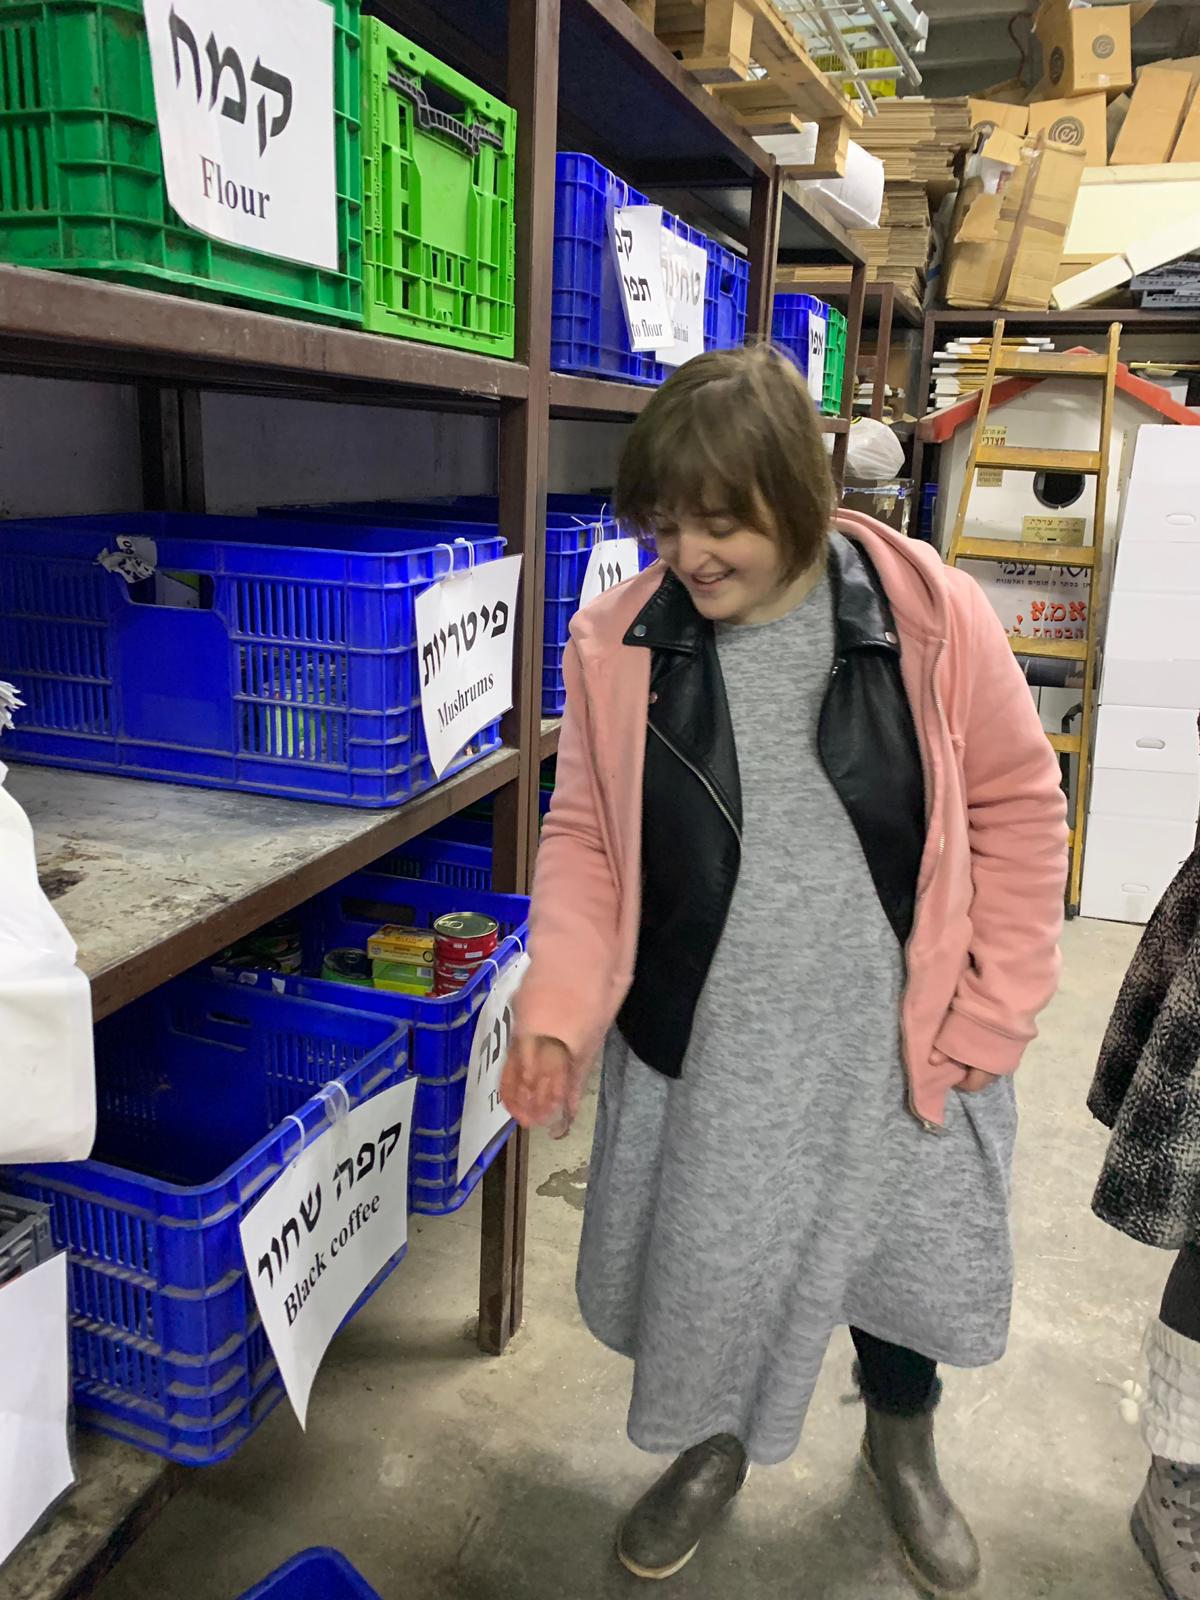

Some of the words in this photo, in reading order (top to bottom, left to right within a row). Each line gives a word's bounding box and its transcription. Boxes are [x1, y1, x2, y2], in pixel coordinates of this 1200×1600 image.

[168, 2, 293, 159] קמח
[200, 155, 271, 220] Flour
[641, 319, 663, 338] flour
[671, 319, 689, 343] ahini
[422, 600, 509, 688] פיטריות
[436, 672, 495, 734] Mushrums
[332, 1121, 402, 1202] קפה
[257, 1181, 323, 1289] שחור
[282, 1251, 328, 1328] Black
[329, 1194, 381, 1258] coffee
